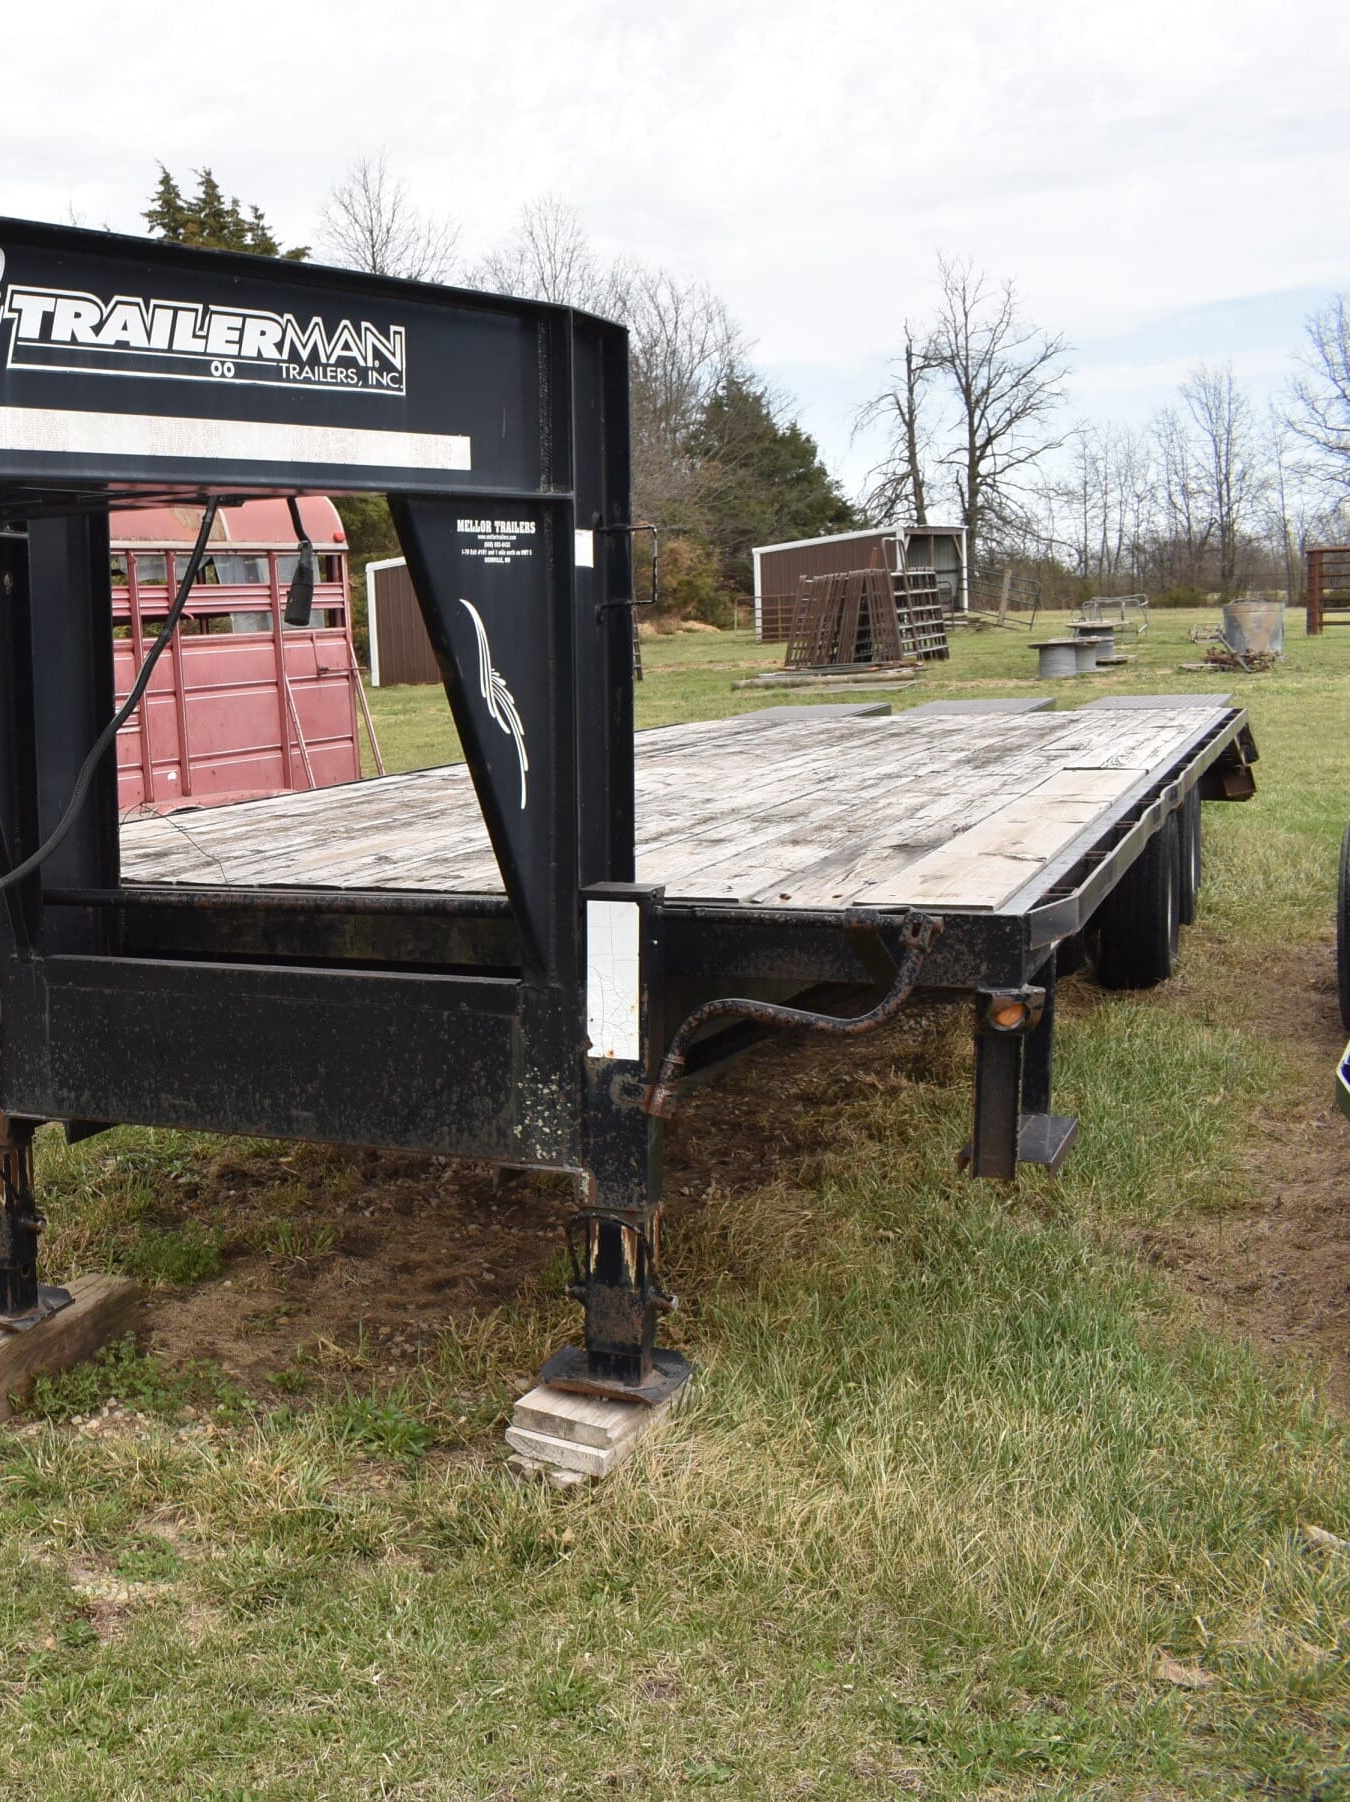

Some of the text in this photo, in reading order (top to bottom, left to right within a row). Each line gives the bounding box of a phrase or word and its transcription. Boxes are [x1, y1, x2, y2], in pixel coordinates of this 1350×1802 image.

[11, 293, 401, 372] TRAILERMAN
[278, 362, 404, 389] TRAILERS, INC.
[457, 519, 536, 534] MELLOR TRAILERS
